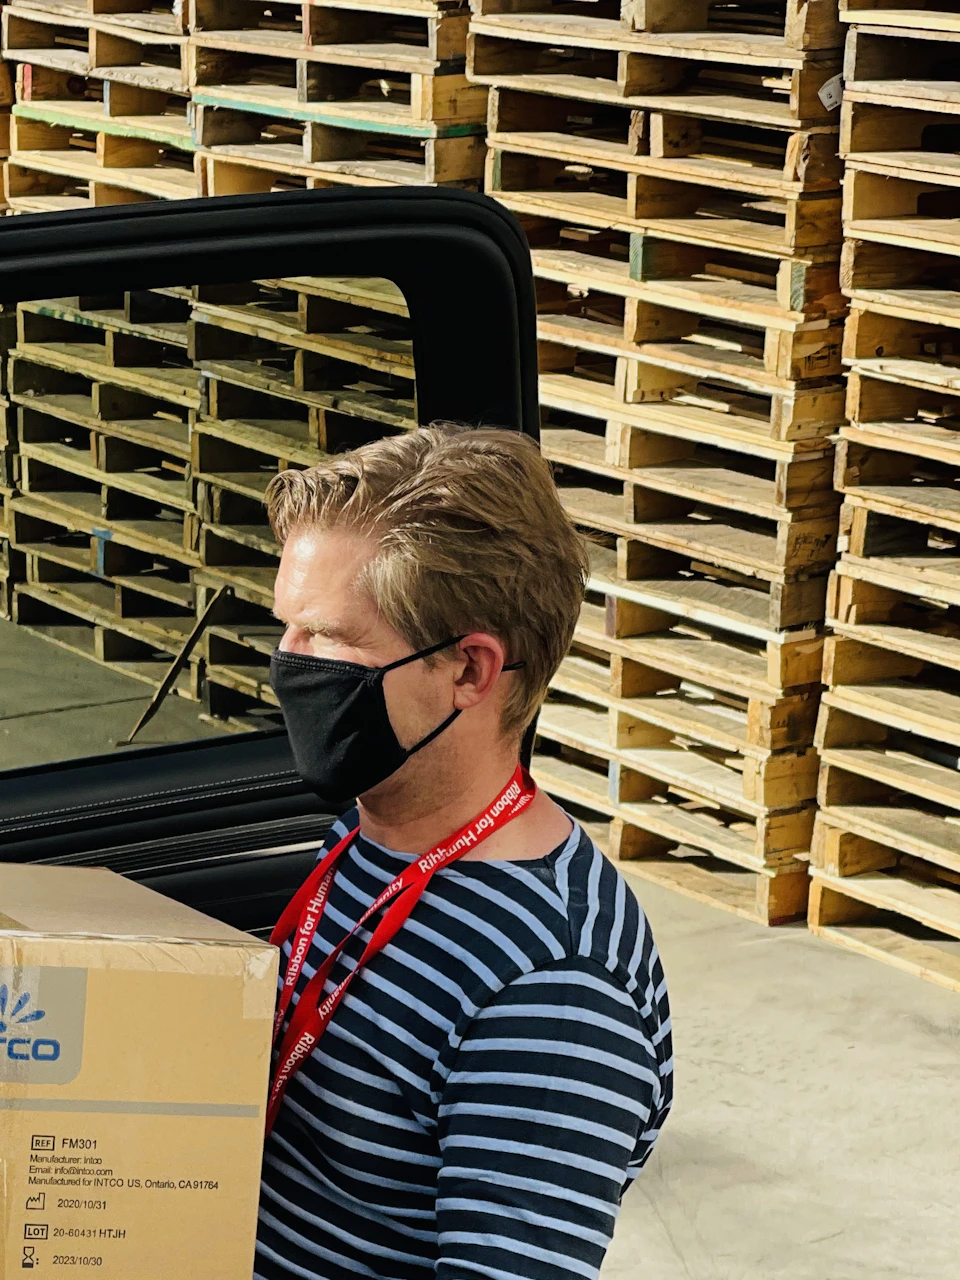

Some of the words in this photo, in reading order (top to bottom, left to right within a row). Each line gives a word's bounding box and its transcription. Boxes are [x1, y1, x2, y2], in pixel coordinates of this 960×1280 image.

[489, 780, 521, 818] Ribbon
[474, 814, 494, 835] for
[285, 938, 308, 986] Ribbon
[300, 914, 316, 935] for
[281, 1032, 315, 1072] Ribbon
[34, 1139, 52, 1148] REF
[61, 1138, 98, 1150] FM301
[29, 1154, 81, 1164] Manufacturer:
[83, 1155, 102, 1165] Intco
[28, 1165, 51, 1175] Email:
[53, 1166, 113, 1176] info@intco.com
[28, 1176, 80, 1187] Manufactured
[82, 1177, 93, 1187] for
[93, 1178, 124, 1188] INTCO
[145, 1179, 176, 1189] Ontario,
[178, 1180, 193, 1190] CA
[193, 1180, 219, 1190] 91764
[57, 1198, 107, 1210] 2020/10/31
[27, 1228, 46, 1236] LOT
[53, 1228, 97, 1238] 20-60431
[98, 1229, 126, 1239] HTJH
[52, 1255, 102, 1266] 2023/10/30
